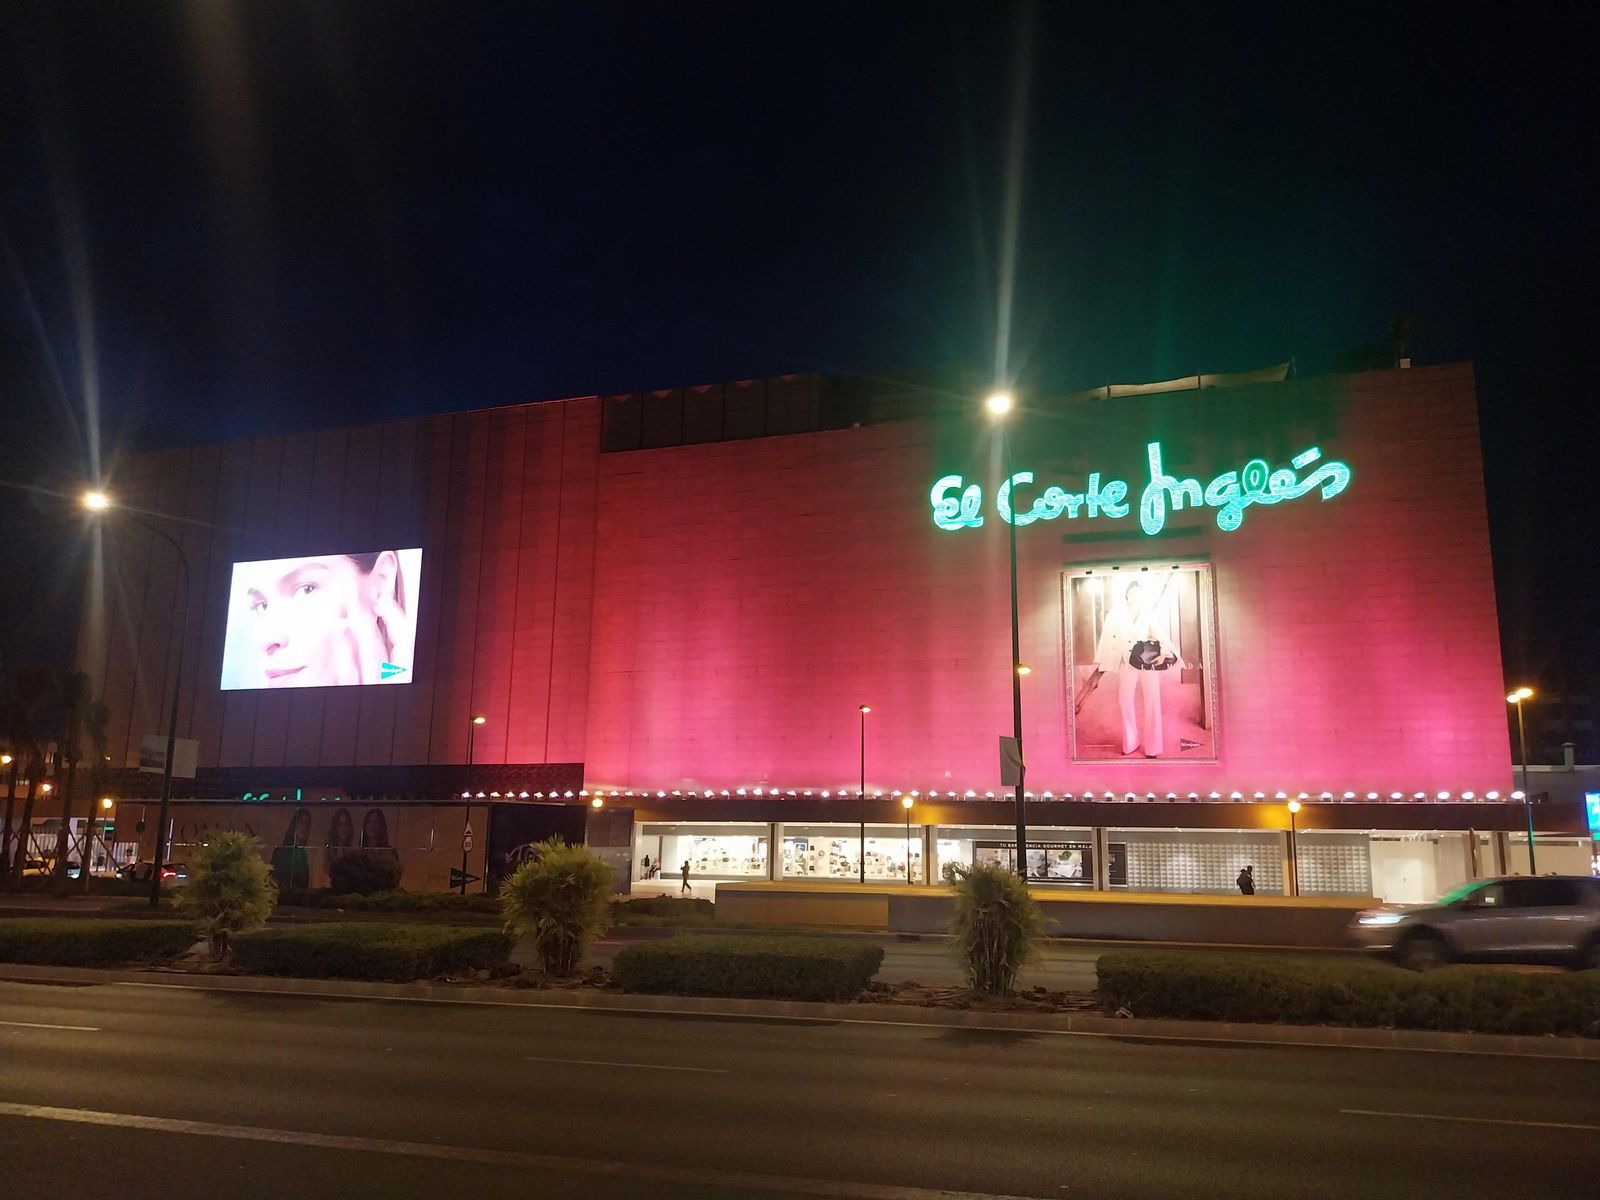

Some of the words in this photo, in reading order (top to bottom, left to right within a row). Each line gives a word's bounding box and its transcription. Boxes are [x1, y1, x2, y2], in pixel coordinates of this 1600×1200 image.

[929, 474, 985, 531] El
[996, 471, 1130, 527] Corte
[1139, 440, 1352, 536] Inglés
